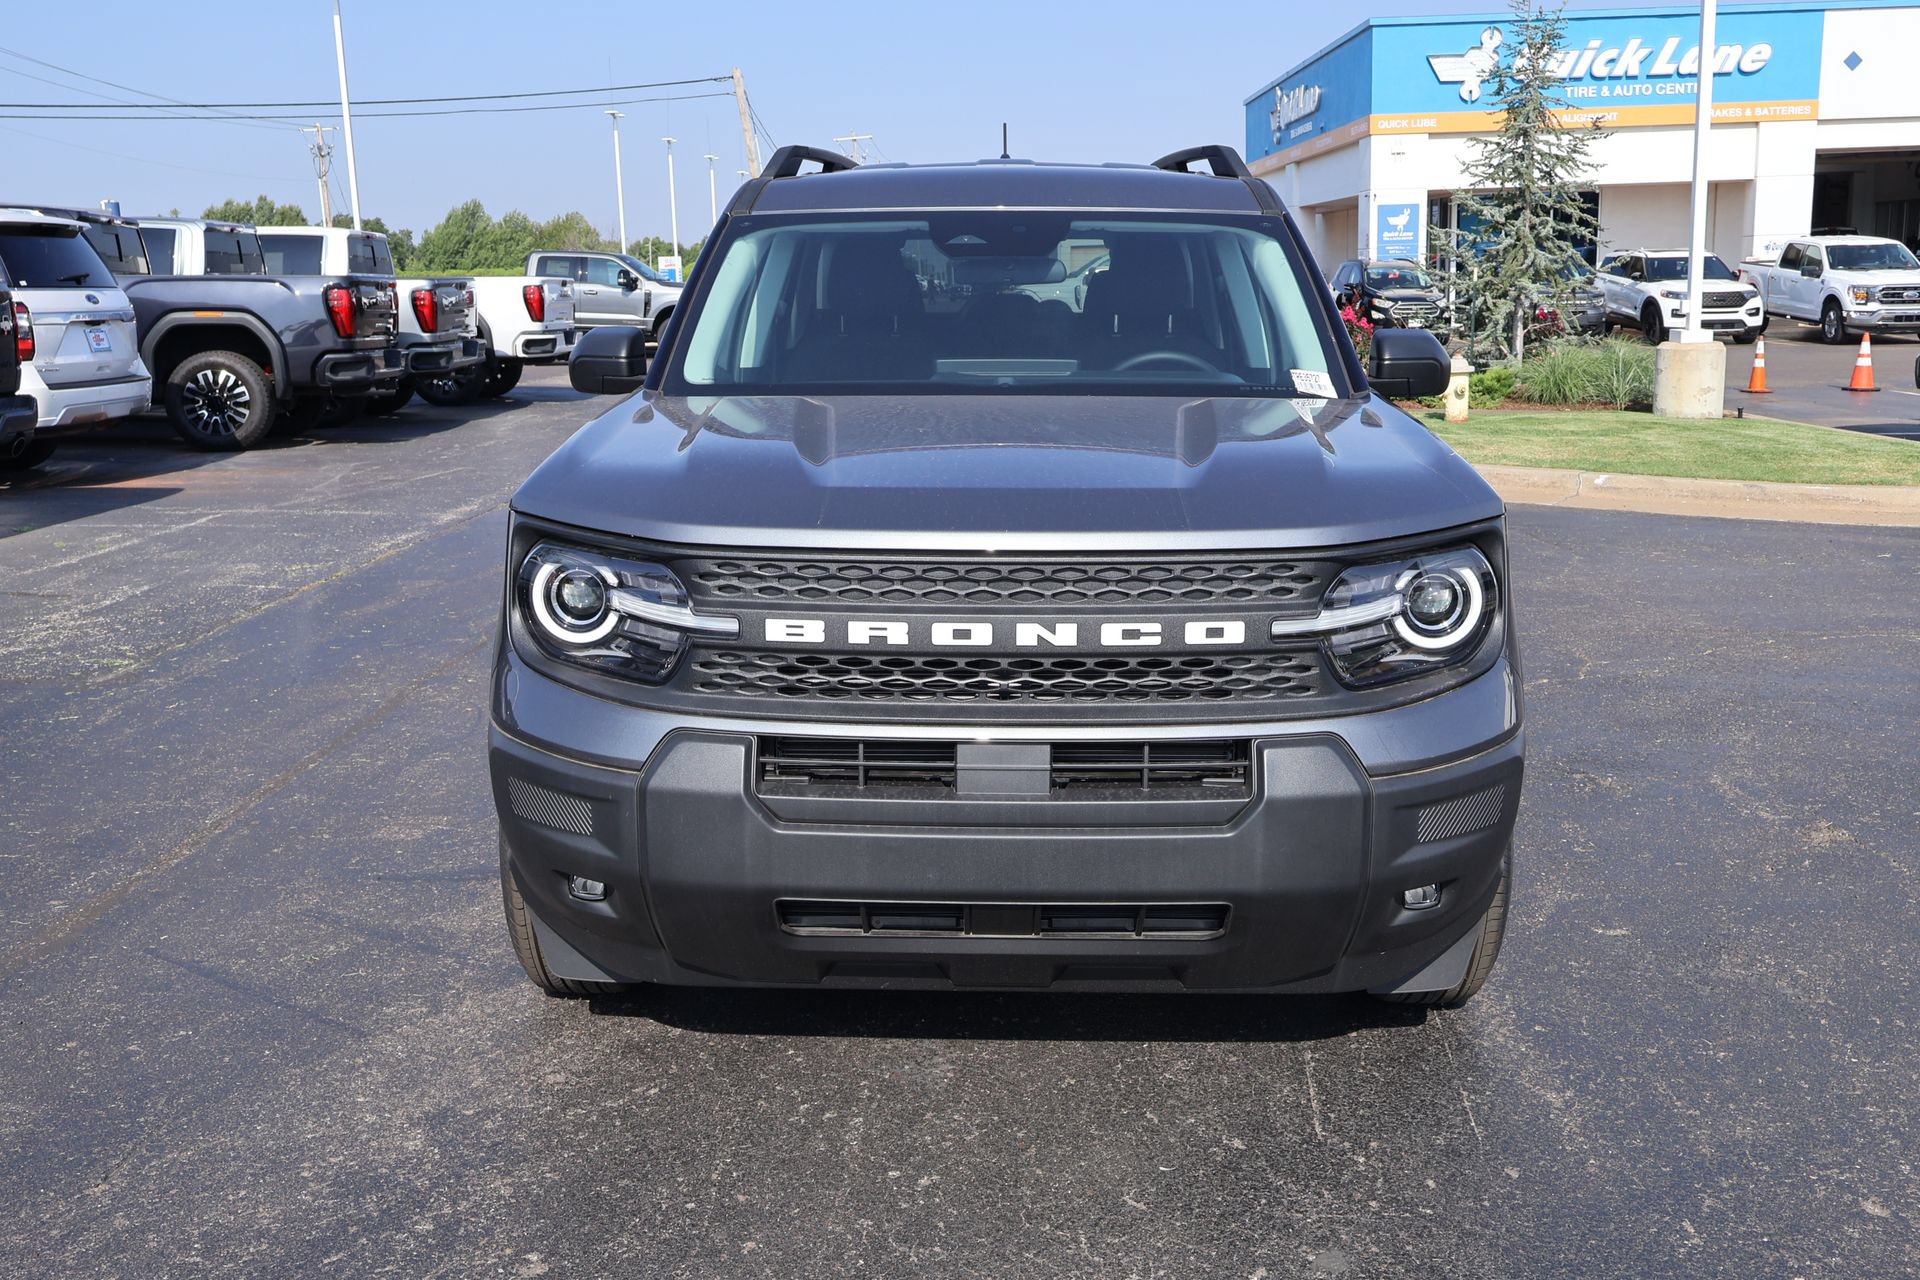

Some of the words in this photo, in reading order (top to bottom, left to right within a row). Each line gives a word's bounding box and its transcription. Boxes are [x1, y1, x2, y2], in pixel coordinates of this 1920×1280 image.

[1565, 86, 1597, 98] TIRE
[1601, 85, 1611, 97] &
[1613, 84, 1653, 96] AUTO
[1656, 82, 1697, 95] CENT
[1711, 107, 1742, 118] RAKES
[1745, 107, 1753, 116] &
[1755, 105, 1812, 116] BATTERIES
[1378, 119, 1409, 129] QUICK
[1411, 118, 1438, 128] LUBE
[764, 617, 1247, 647] BRONCO
